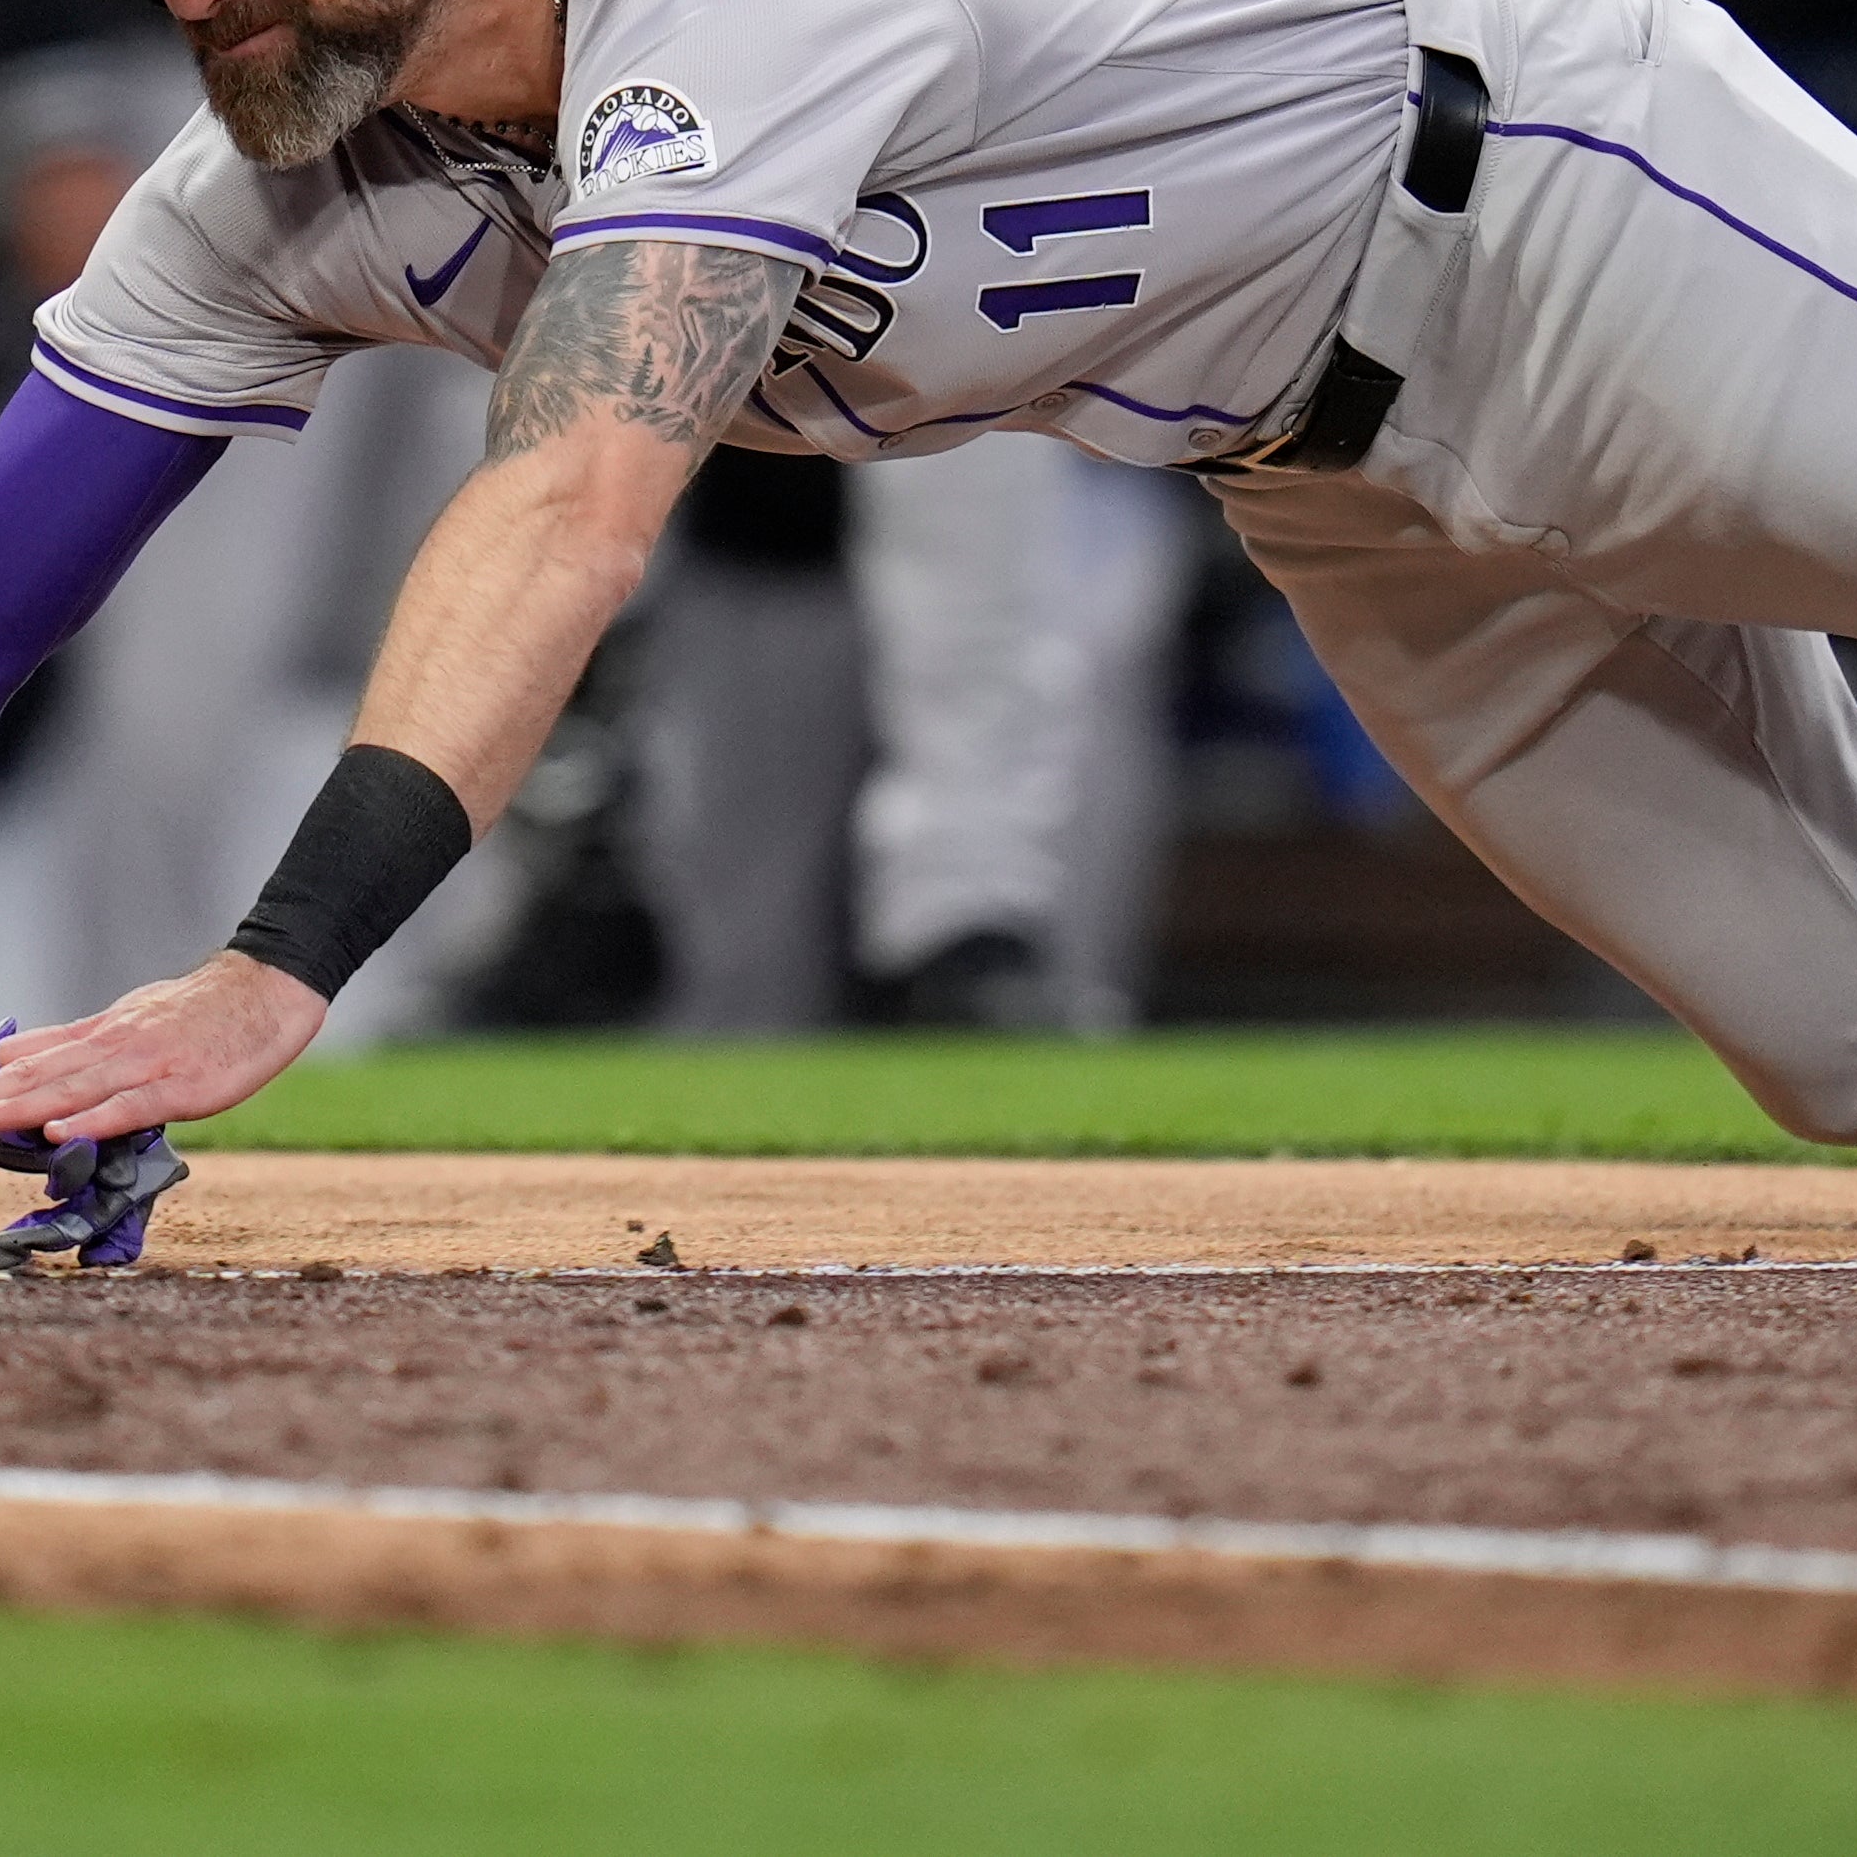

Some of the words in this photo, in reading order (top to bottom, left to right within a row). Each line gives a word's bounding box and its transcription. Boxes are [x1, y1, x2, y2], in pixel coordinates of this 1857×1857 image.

[580, 134, 706, 197] ROCKIES
[581, 88, 690, 167] COLORADO
[974, 186, 1153, 334] 11
